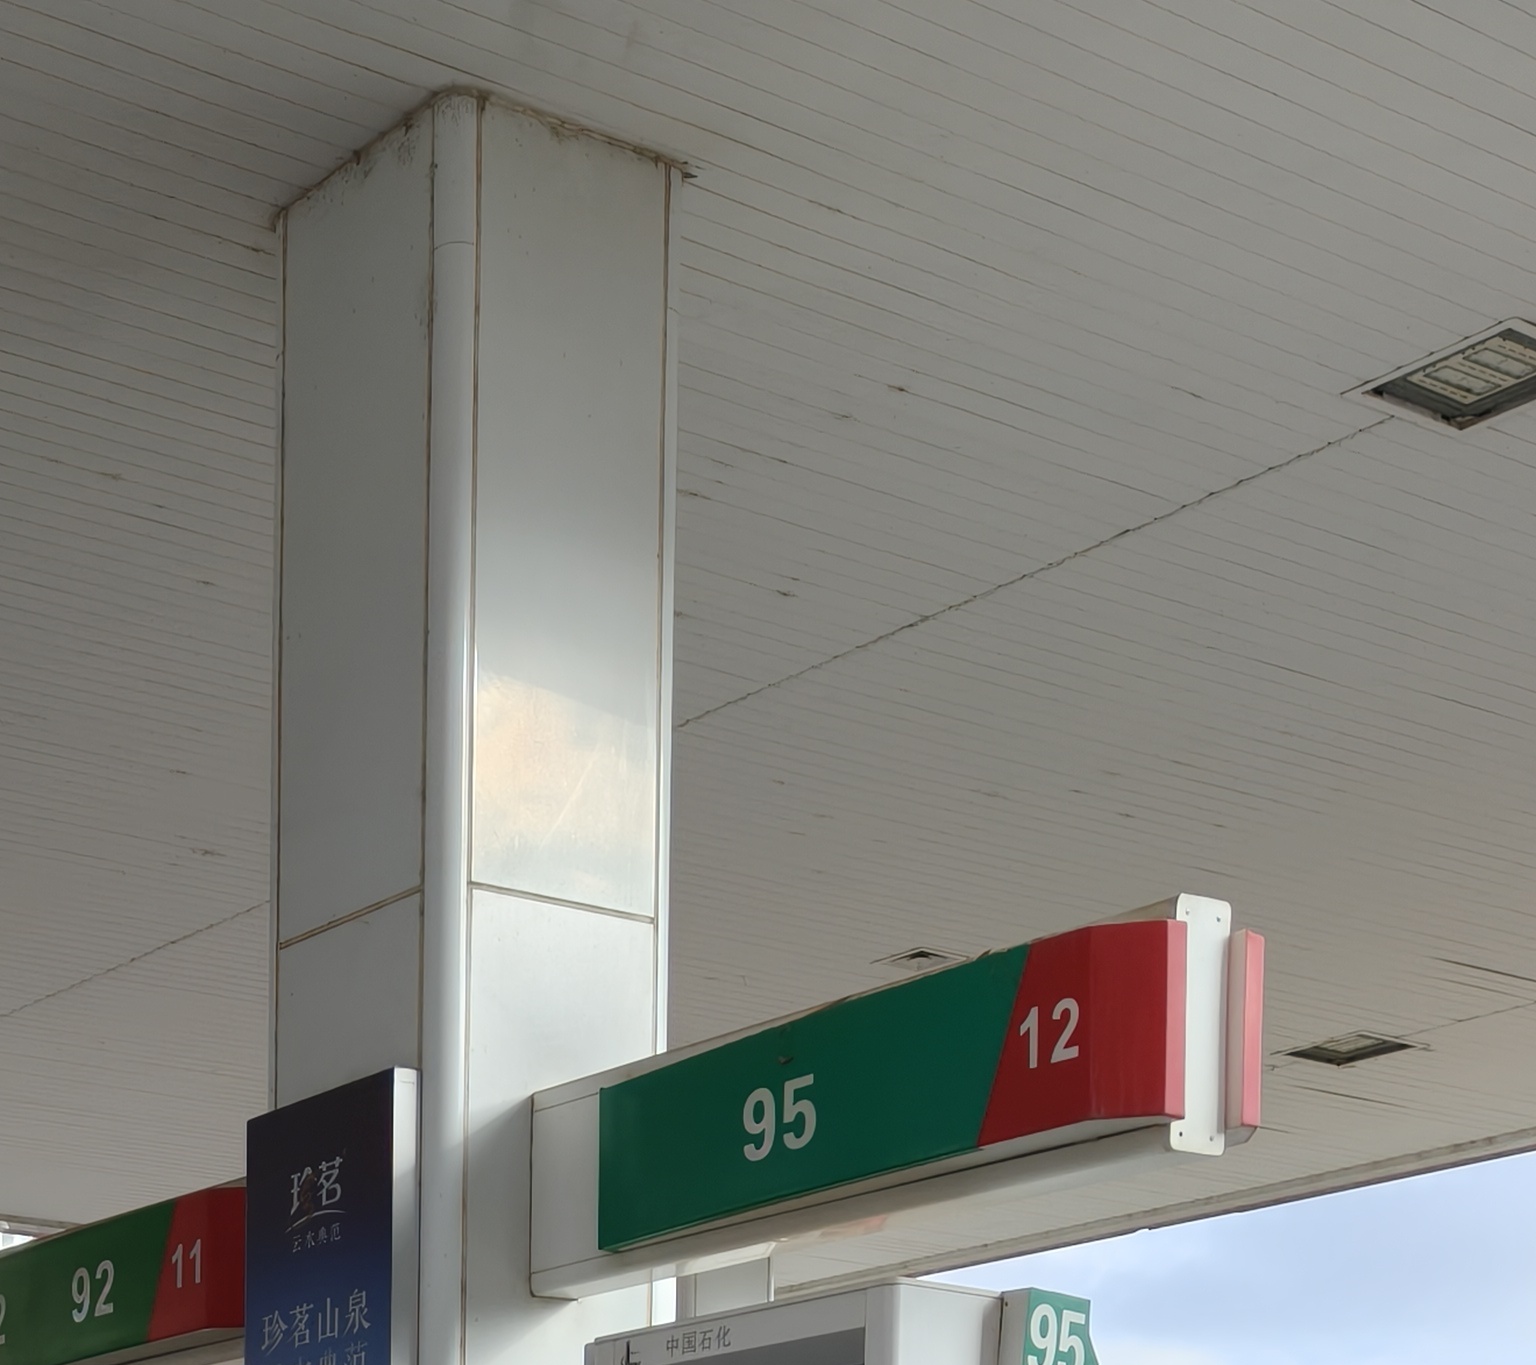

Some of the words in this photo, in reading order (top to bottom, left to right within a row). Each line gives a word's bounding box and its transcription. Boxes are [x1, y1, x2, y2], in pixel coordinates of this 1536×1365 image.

[743, 1073, 816, 1161] 95
[1019, 997, 1080, 1069] 12
[71, 1259, 114, 1323] 92
[171, 1238, 202, 1289] 11
[261, 1288, 371, 1356] 珍茗山泉
[666, 1325, 731, 1358] 中国石化
